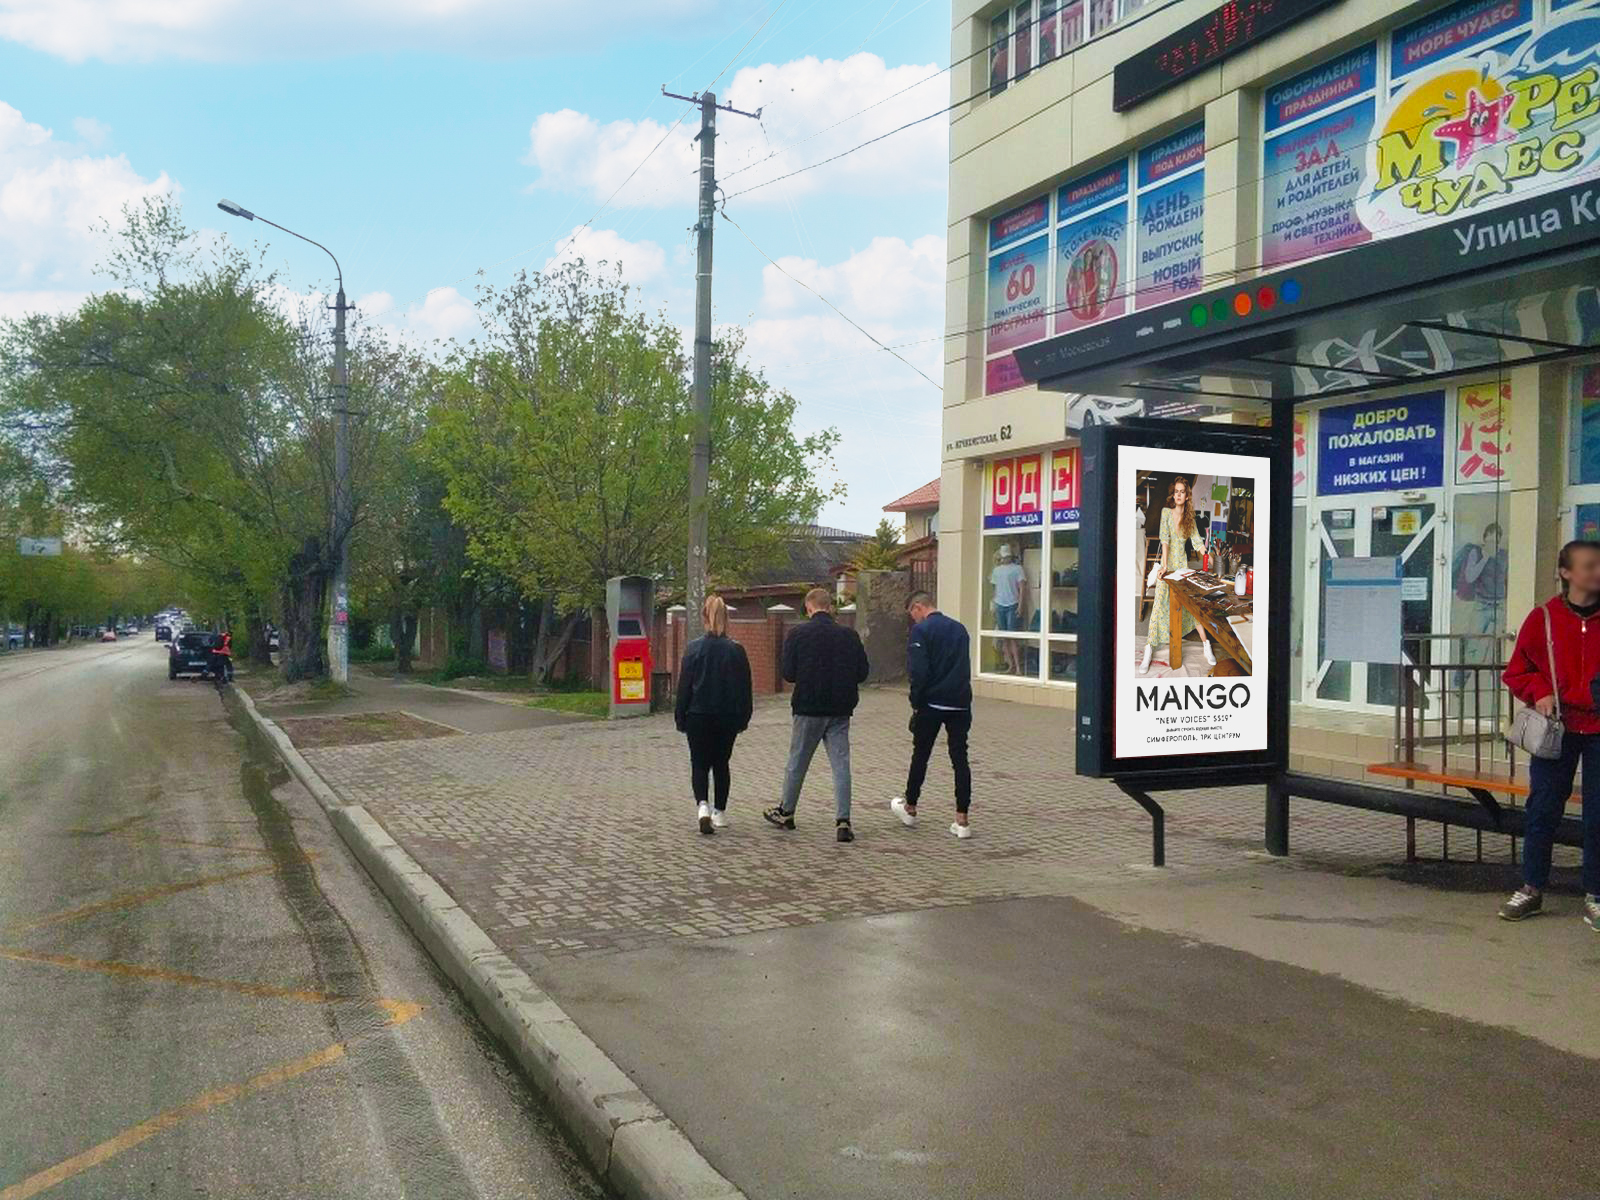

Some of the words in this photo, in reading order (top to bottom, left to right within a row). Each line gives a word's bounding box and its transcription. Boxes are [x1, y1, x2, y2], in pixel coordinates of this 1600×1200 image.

[1407, 29, 1455, 61] МОРЕ
[1456, 4, 1515, 38] ЧУДЕС
[1272, 50, 1370, 106] ОФОРМЛЕНИЕ
[1284, 77, 1354, 117] ПРАЗДНИКА
[1154, 159, 1175, 174] ПОД
[1175, 144, 1204, 167] КЛЮЧ
[1295, 139, 1340, 173] ЗАЛ
[1277, 197, 1286, 209] И
[1288, 166, 1360, 206] РОДИТЕЛЕЙ
[1285, 173, 1310, 193] ДЛЯ
[1312, 155, 1351, 183] ДЕТЕЙ
[1399, 130, 1585, 217] ЧУДЕС
[1142, 191, 1190, 227] ДЕНЬ
[1305, 198, 1354, 222] МУЗЫКА
[1283, 231, 1292, 242] И
[1293, 212, 1350, 240] СВЕТОВАЯ
[1313, 222, 1362, 246] ТЕХНИКА
[1452, 208, 1563, 256] Улица
[1006, 263, 1036, 302] 60
[1152, 252, 1201, 284] НОВЫЙ
[1172, 274, 1200, 293] ГОД
[1000, 424, 1012, 441] 62
[1352, 407, 1409, 430] ДОБРО
[1328, 424, 1436, 450] ПОЖАЛОВАТЬ
[1349, 457, 1356, 467] В
[1358, 452, 1404, 466] МАГАЗИН
[1333, 470, 1388, 487] НИЗКИХ
[1004, 514, 1040, 526] ОДЕЖДА
[1054, 511, 1062, 521] И
[1136, 682, 1251, 712] MANGO
[1155, 716, 1178, 725] "NEW
[1180, 714, 1211, 724] VOICES"
[1146, 734, 1198, 743] СИМФЕРОПОЛЬ,
[1213, 732, 1241, 741] ЦЕНТРУМ
